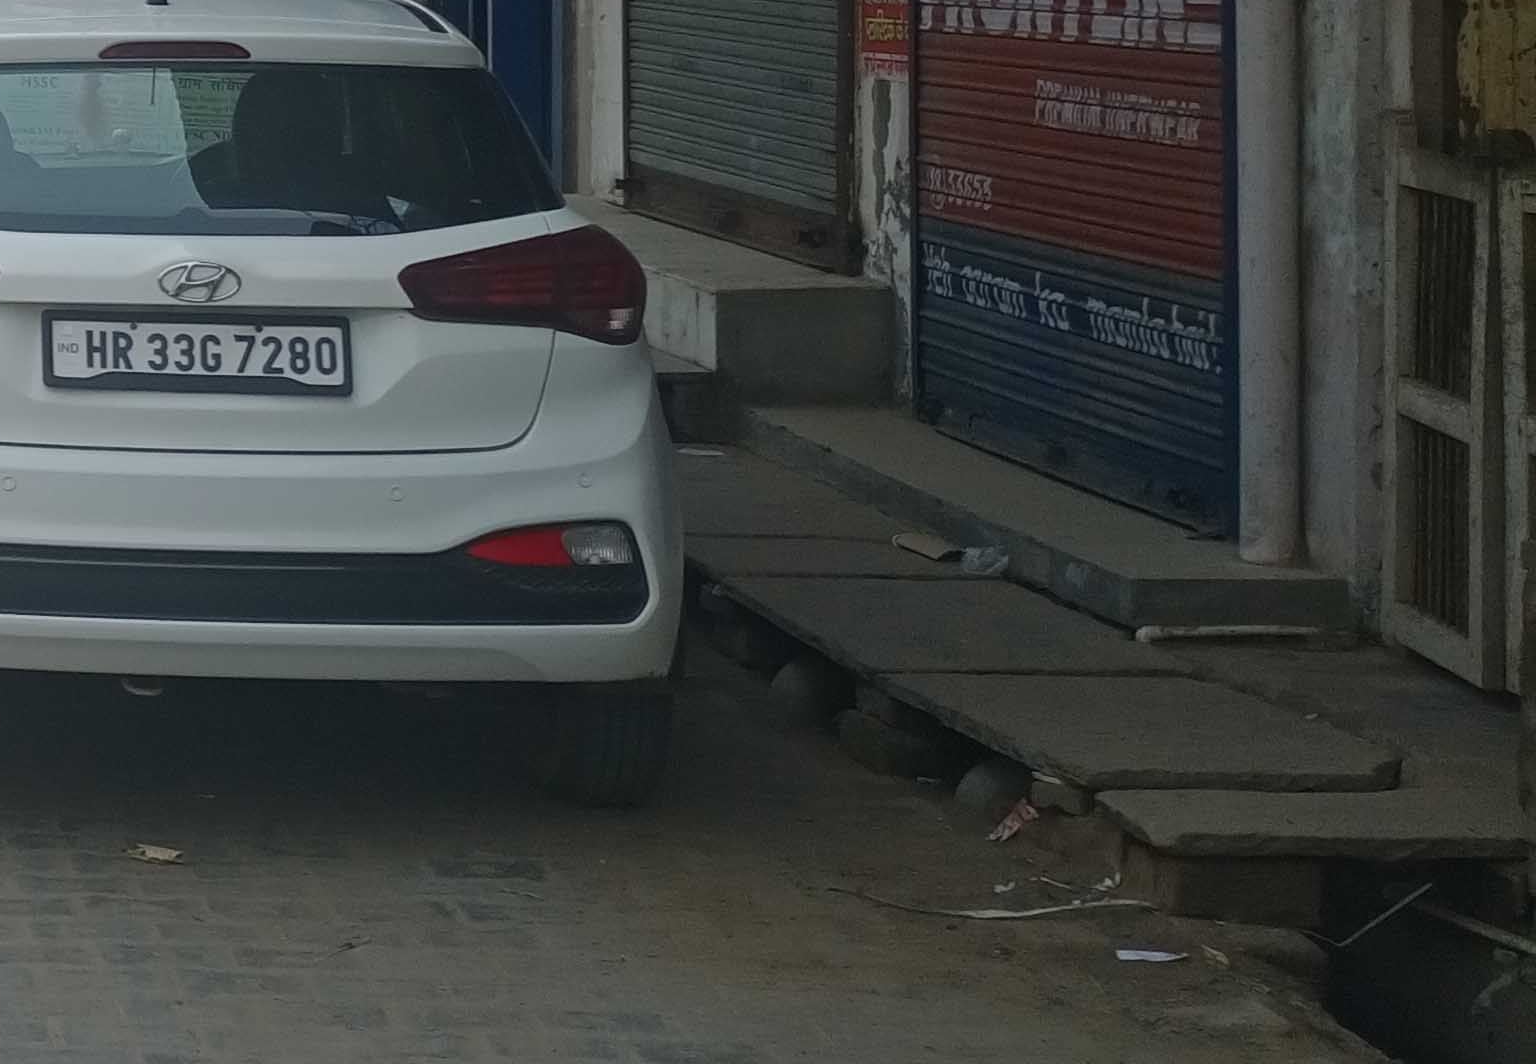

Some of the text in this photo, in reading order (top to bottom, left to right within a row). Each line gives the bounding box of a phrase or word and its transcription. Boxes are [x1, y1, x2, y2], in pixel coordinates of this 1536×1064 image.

[1033, 271, 1071, 331] ka
[57, 330, 338, 376] IND HR 33G 7280
